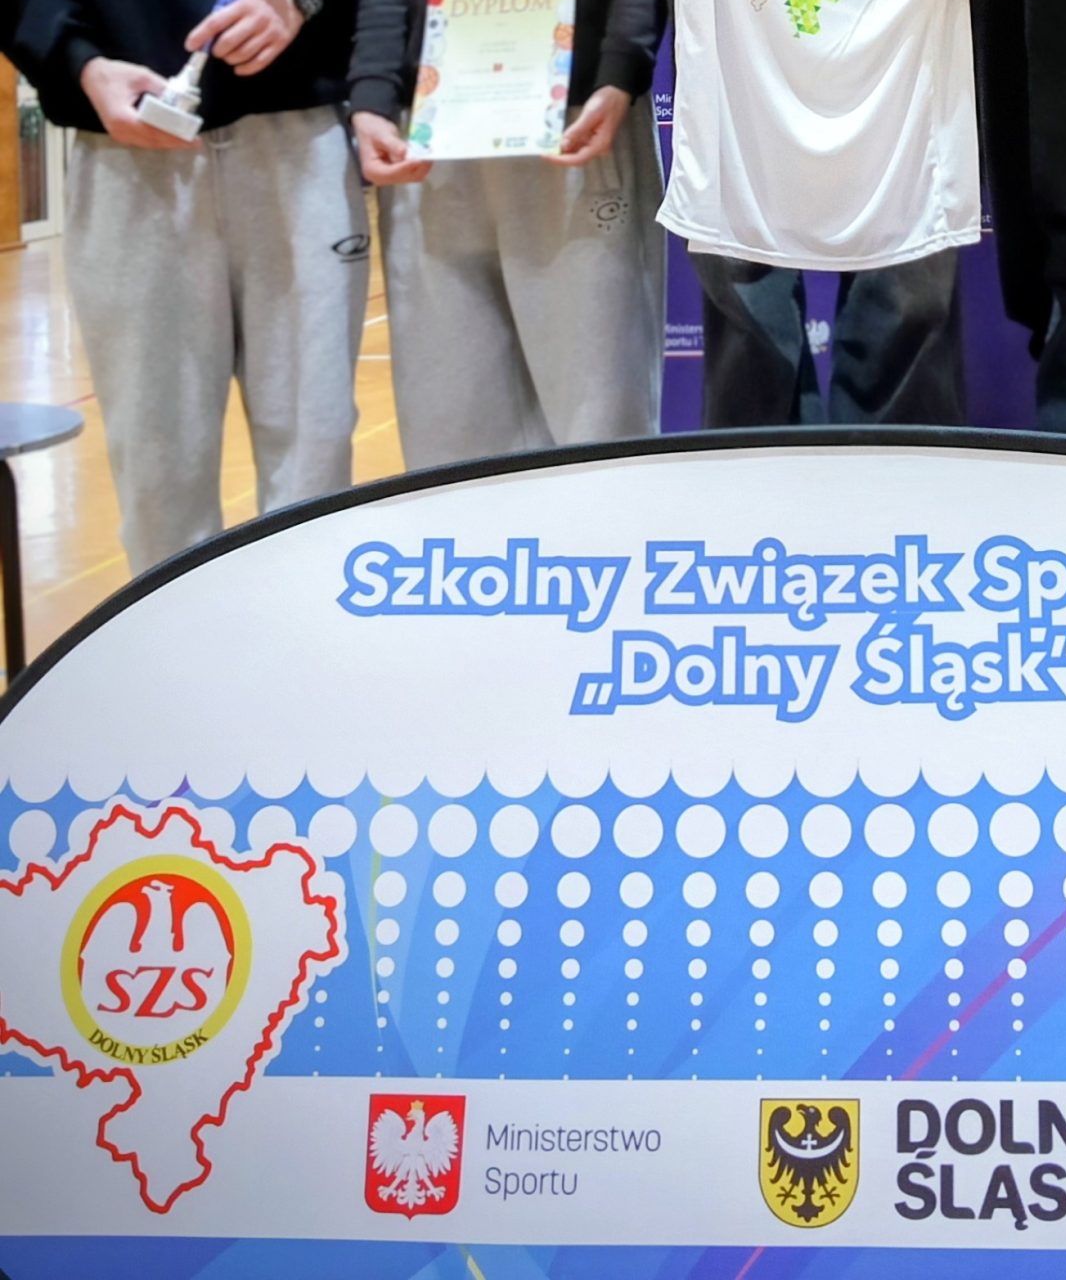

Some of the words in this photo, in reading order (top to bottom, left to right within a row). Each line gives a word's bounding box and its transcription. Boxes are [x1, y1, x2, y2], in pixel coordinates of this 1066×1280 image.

[345, 544, 622, 627] Szkolny
[650, 542, 952, 626] Związek
[97, 966, 214, 1018] SZS
[88, 1029, 148, 1064] DOLNY
[151, 1043, 209, 1064] ŚLĄSK
[486, 1124, 661, 1152] Ministerstwo
[485, 1166, 578, 1200] Sportu
